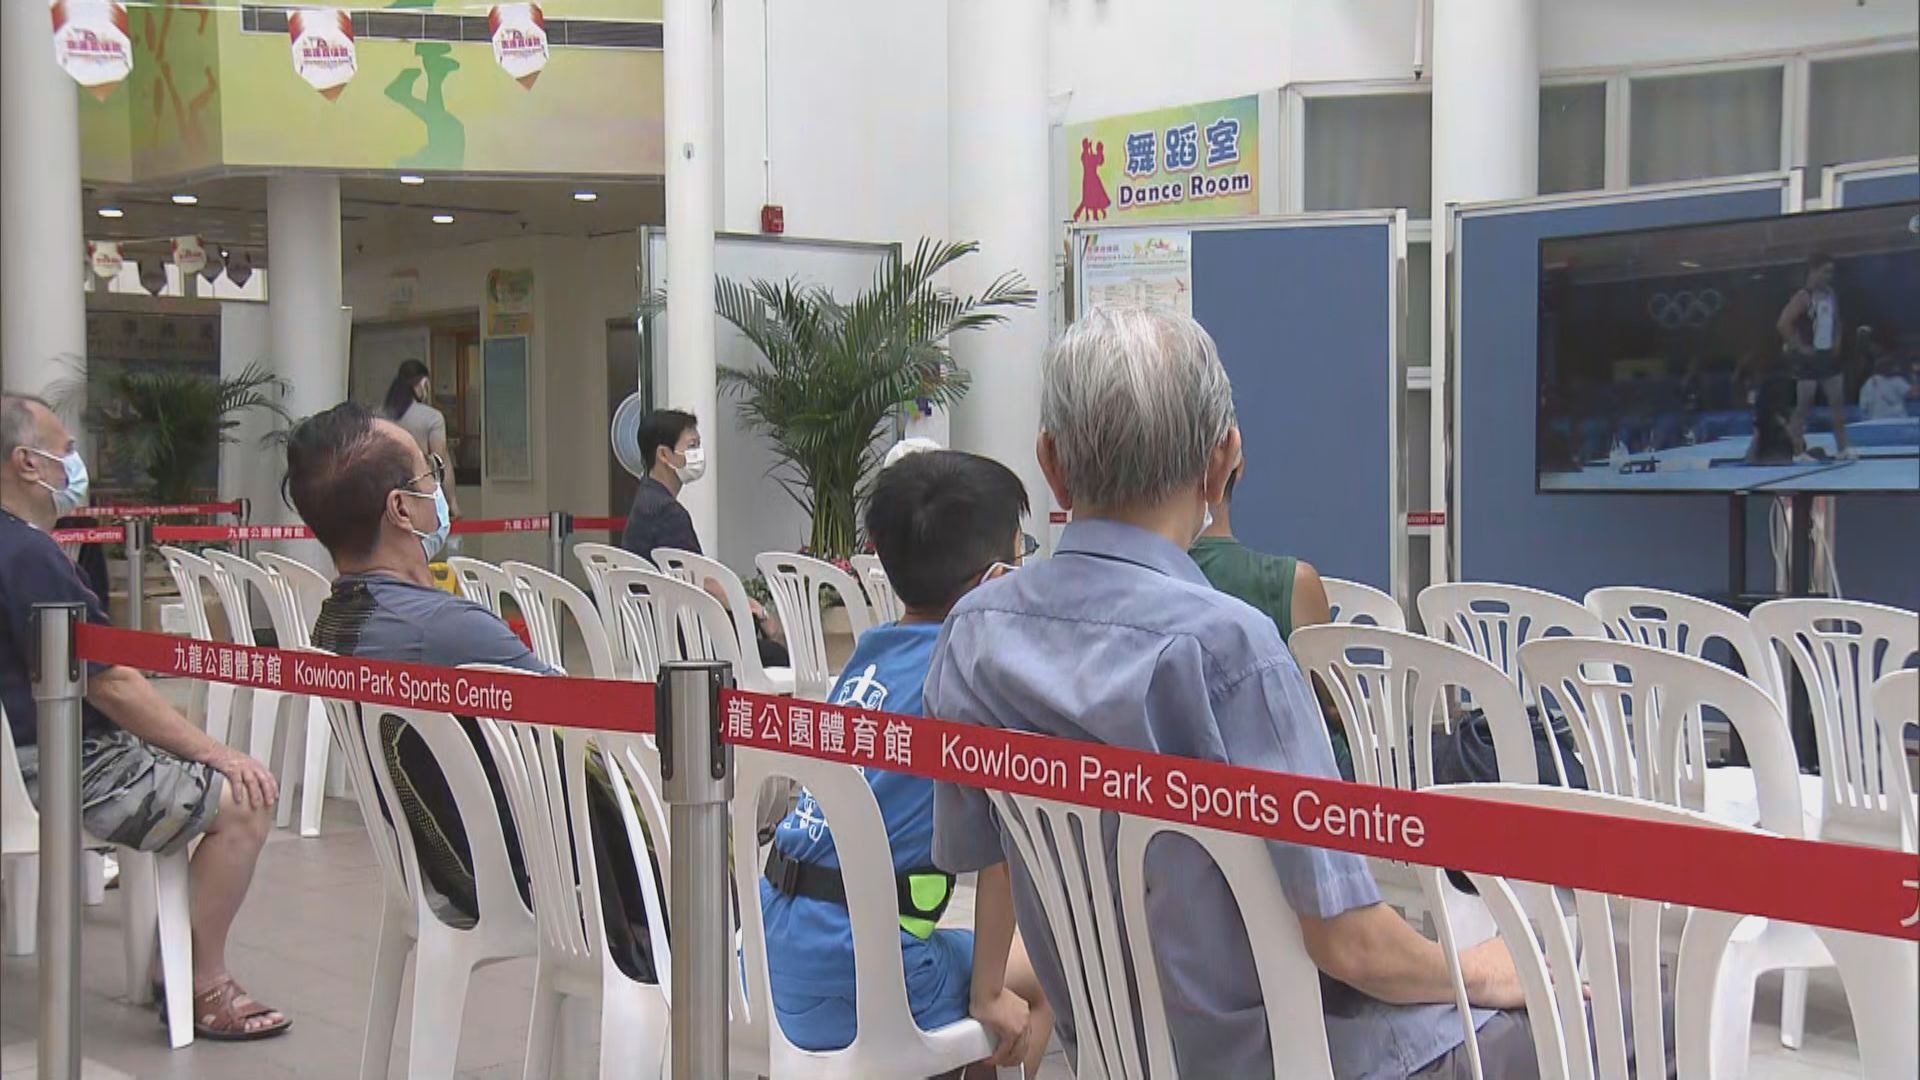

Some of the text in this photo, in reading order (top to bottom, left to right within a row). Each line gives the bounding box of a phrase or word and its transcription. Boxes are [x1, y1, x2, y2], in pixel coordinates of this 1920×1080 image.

[1126, 118, 1239, 175] 舞蹈室
[1119, 174, 1249, 205] Dance Room
[87, 529, 122, 541] Centre
[174, 641, 513, 711] 九龍公園體育館 Kowloon Park Sports Centre
[719, 696, 1425, 847] 龍公園體育館 Kowloon Park Sports Centre
